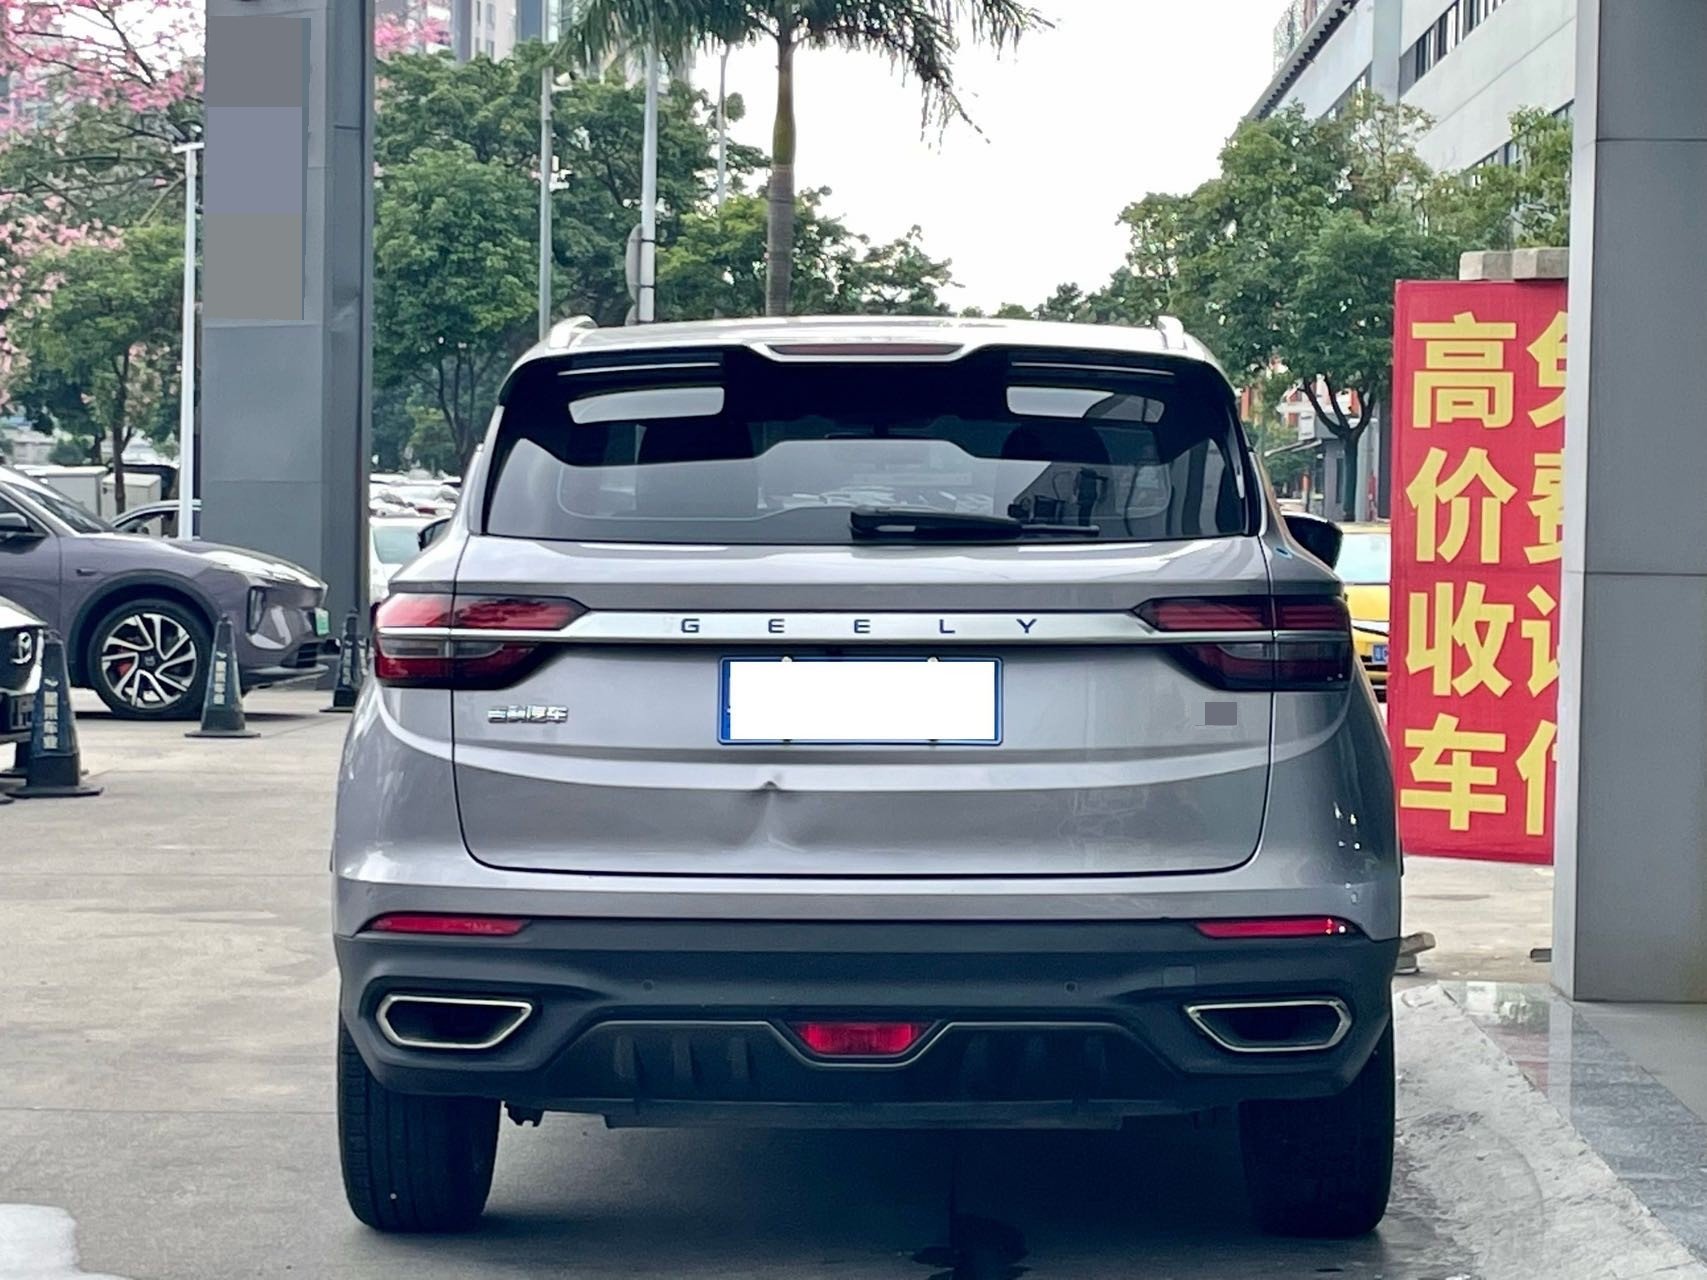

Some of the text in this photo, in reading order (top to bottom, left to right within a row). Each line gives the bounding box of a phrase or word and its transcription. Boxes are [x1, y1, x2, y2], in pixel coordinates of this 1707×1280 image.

[680, 618, 1037, 634] GEELY
[1401, 311, 1518, 832] 高价收车
